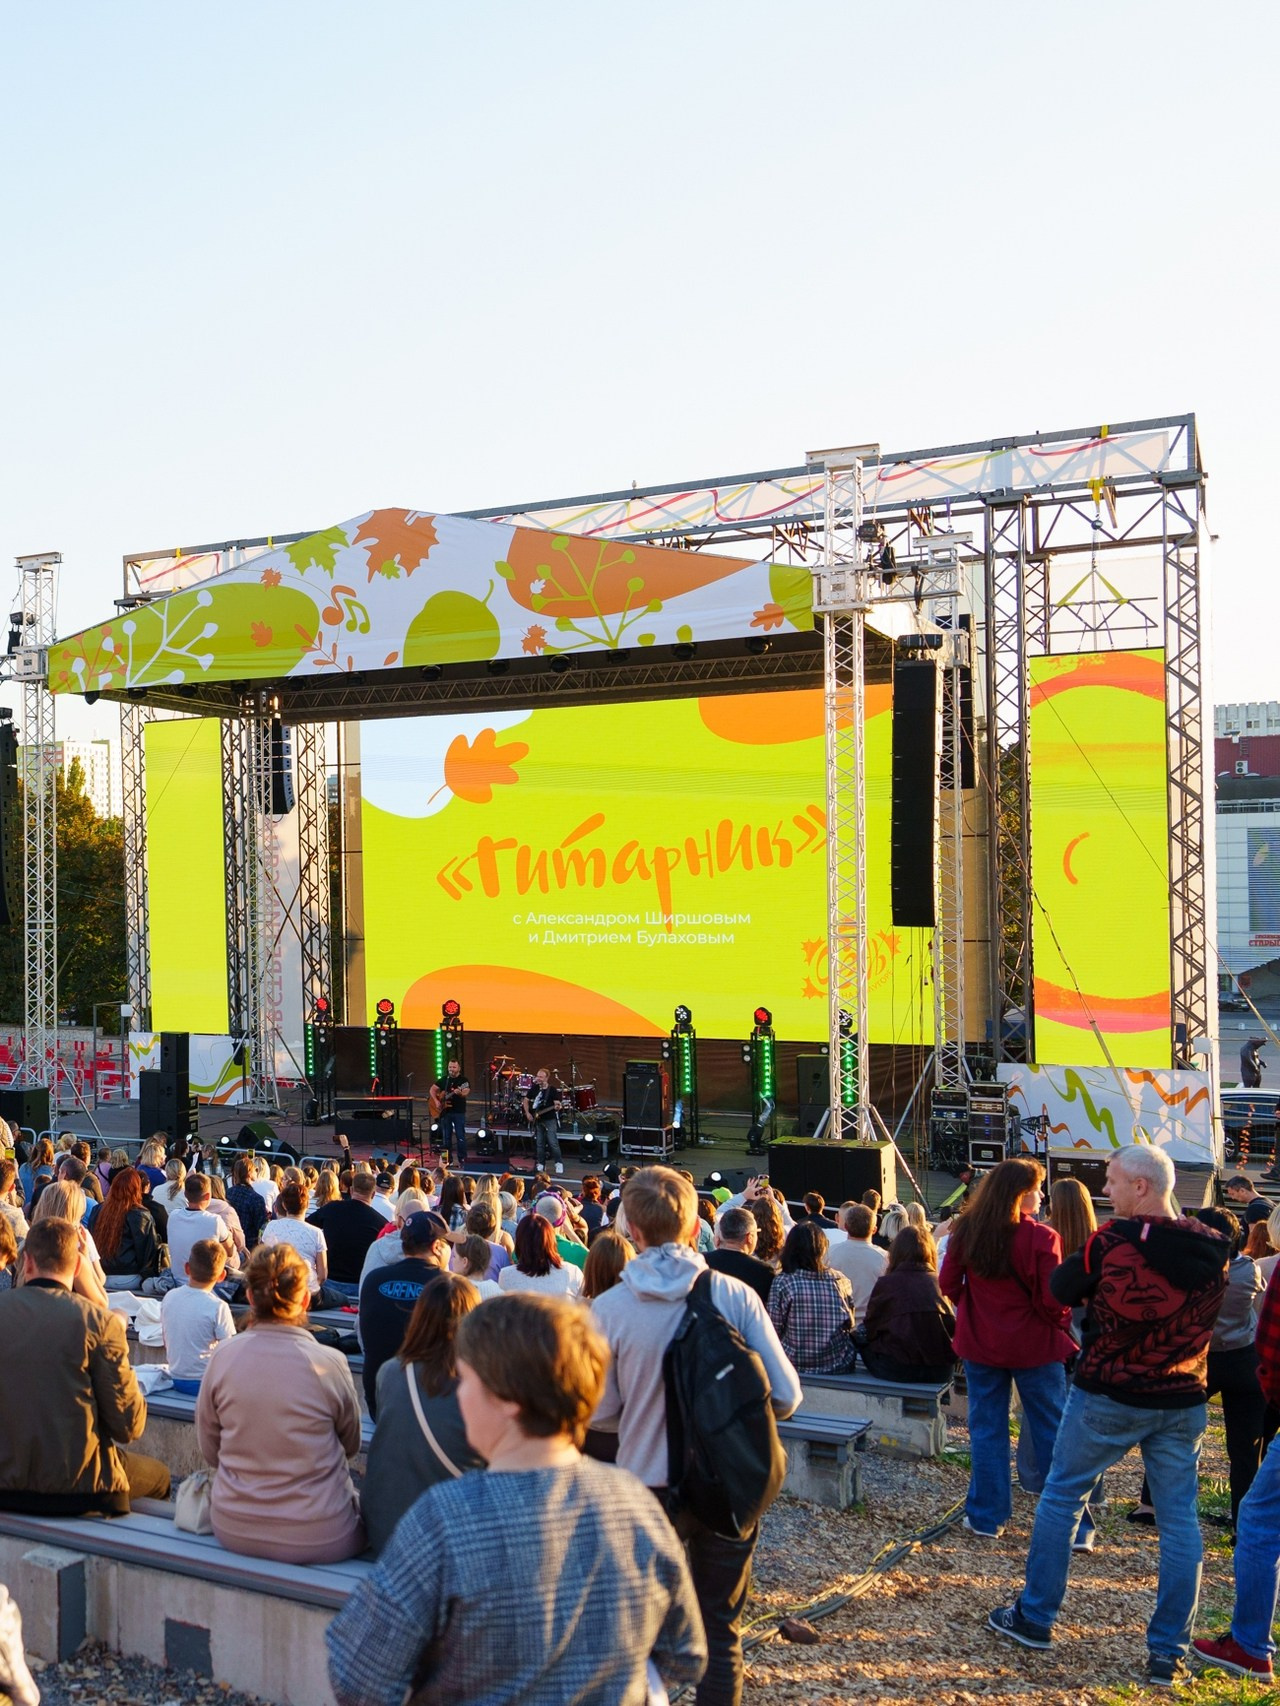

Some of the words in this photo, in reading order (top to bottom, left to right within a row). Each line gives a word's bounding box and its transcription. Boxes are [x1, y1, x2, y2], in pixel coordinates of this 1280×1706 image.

[513, 915, 521, 925] с
[526, 912, 640, 927] Александром
[645, 911, 751, 927] Ширшовым
[528, 933, 539, 943] и
[542, 931, 632, 945] Дмитрием
[637, 930, 735, 946] Булаховым
